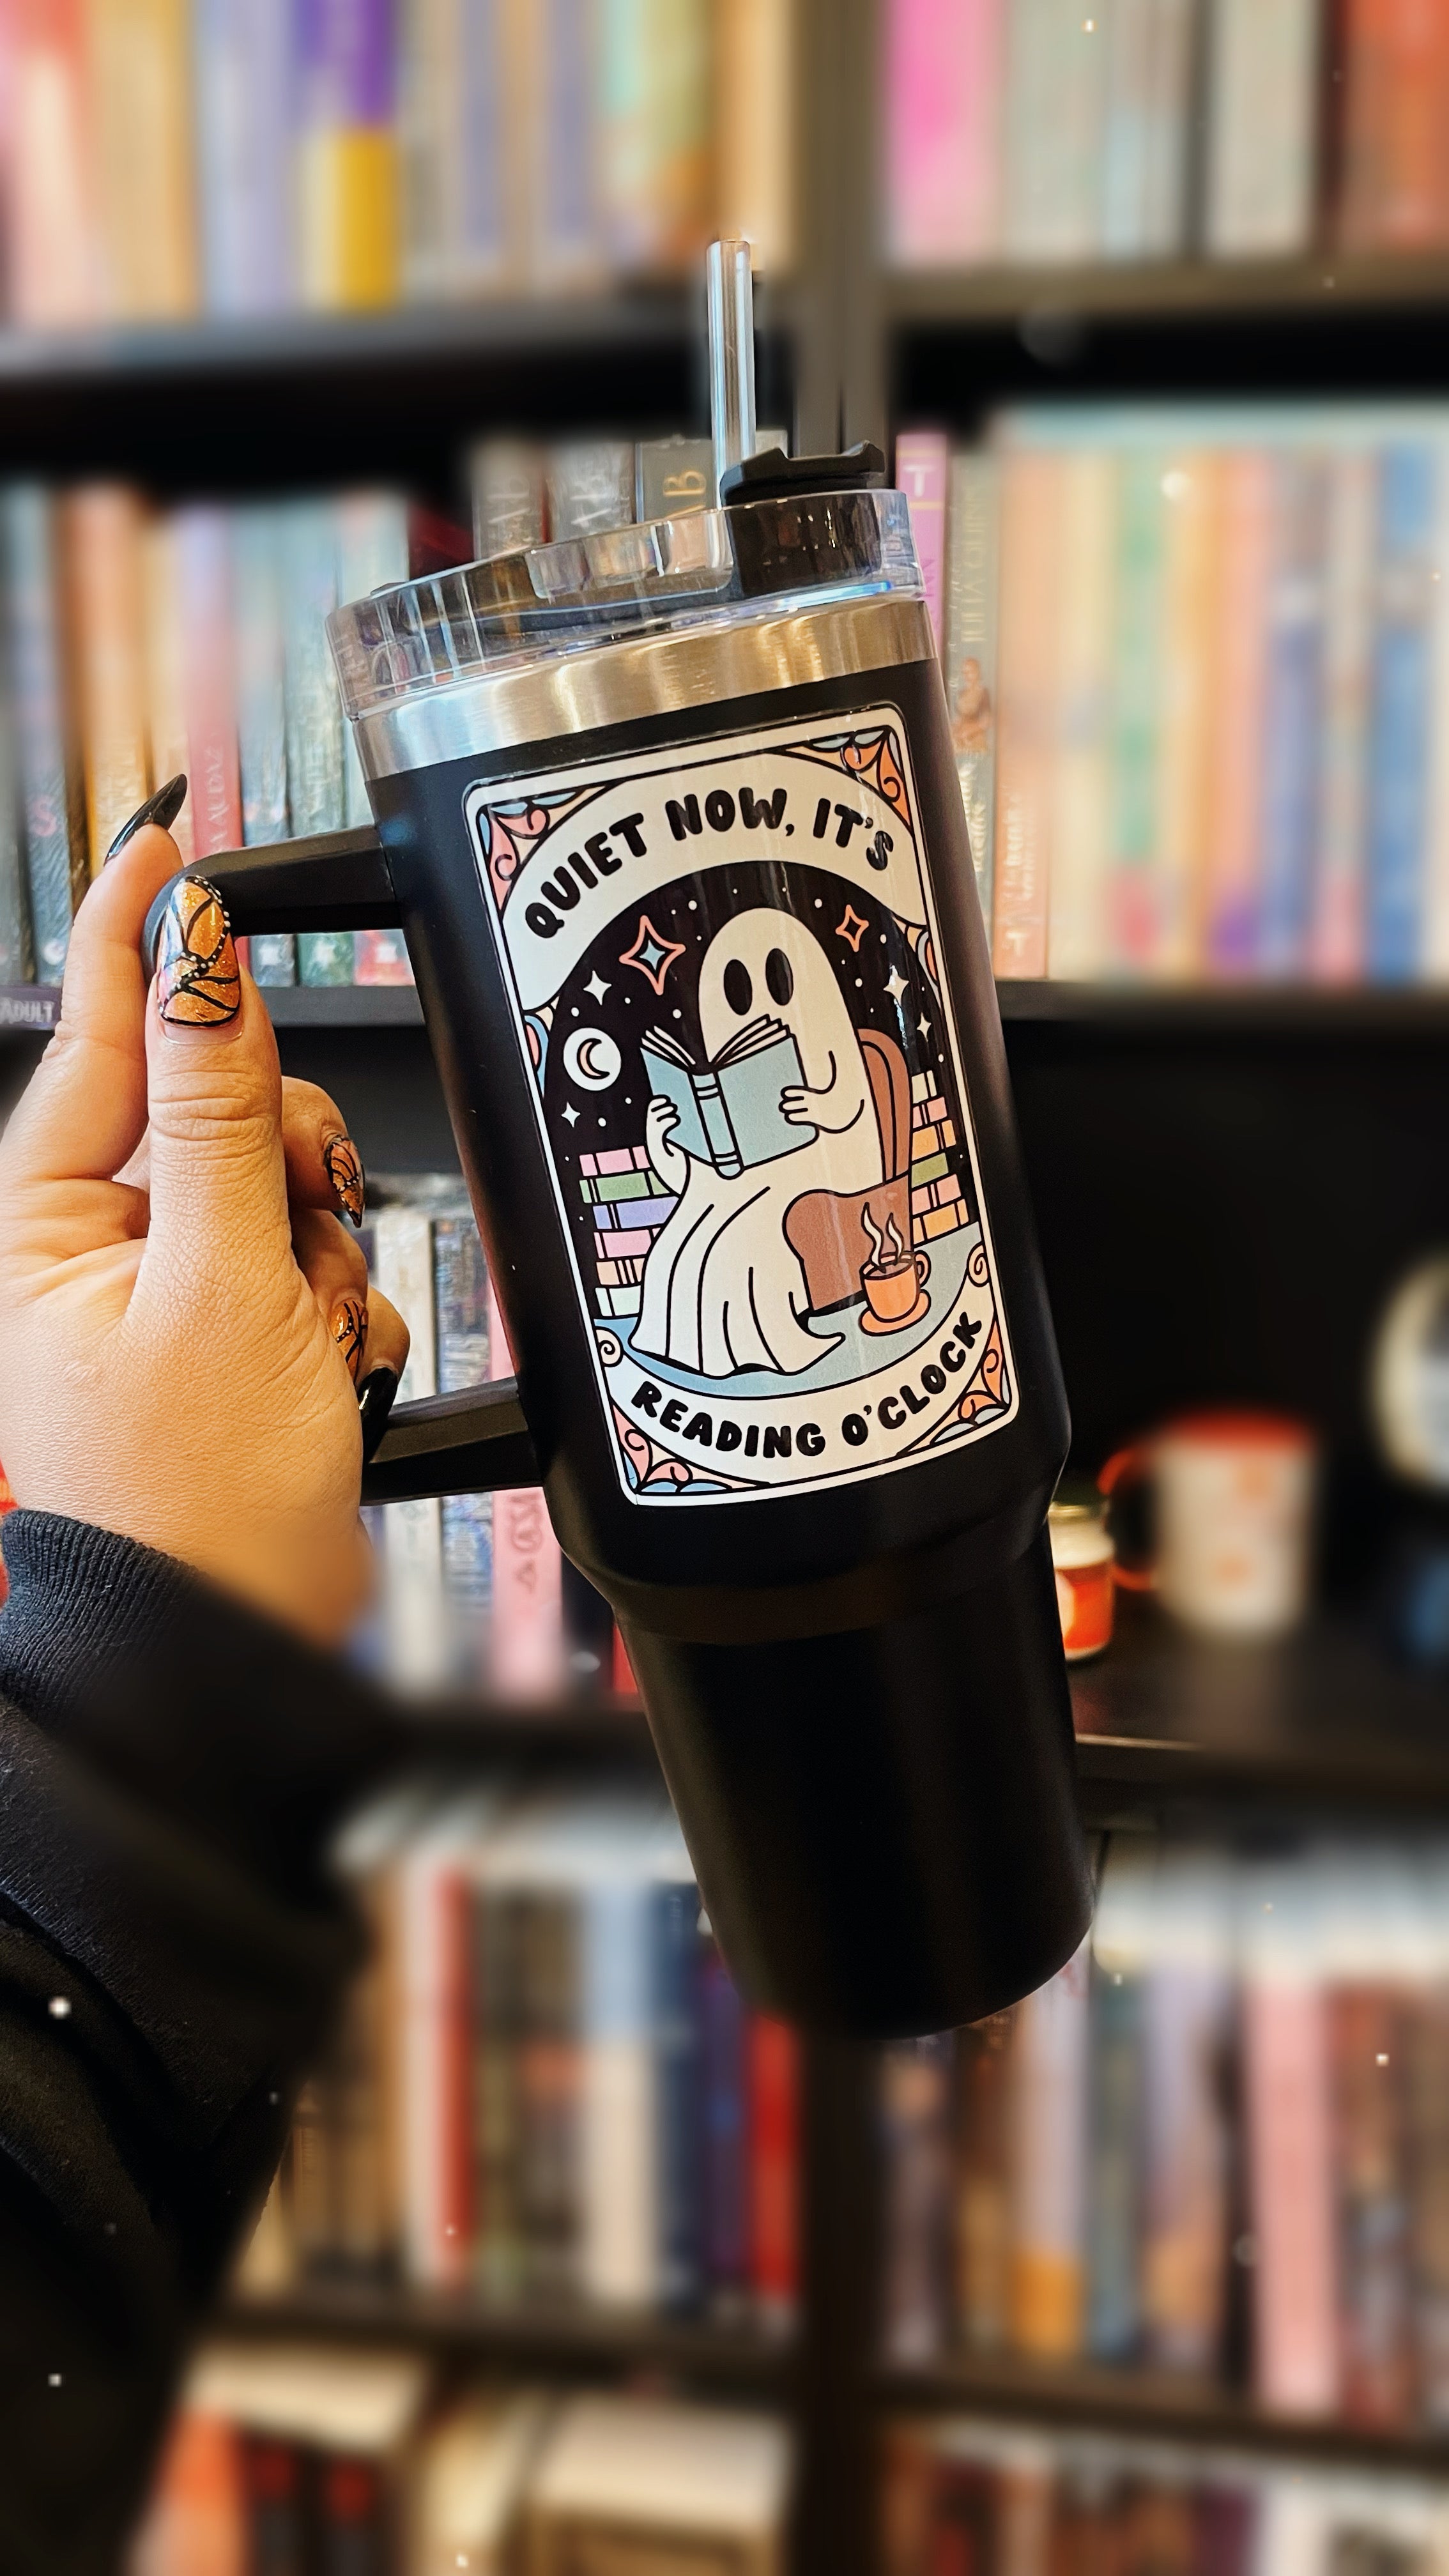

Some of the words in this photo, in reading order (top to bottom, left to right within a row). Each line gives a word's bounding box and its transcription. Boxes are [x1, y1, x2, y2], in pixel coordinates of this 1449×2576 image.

[525, 812, 648, 939] QUIET
[665, 787, 795, 841] NOW,
[813, 797, 894, 871] IT'S
[631, 1381, 826, 1459] READING
[841, 1311, 983, 1446] O'CLOCK
